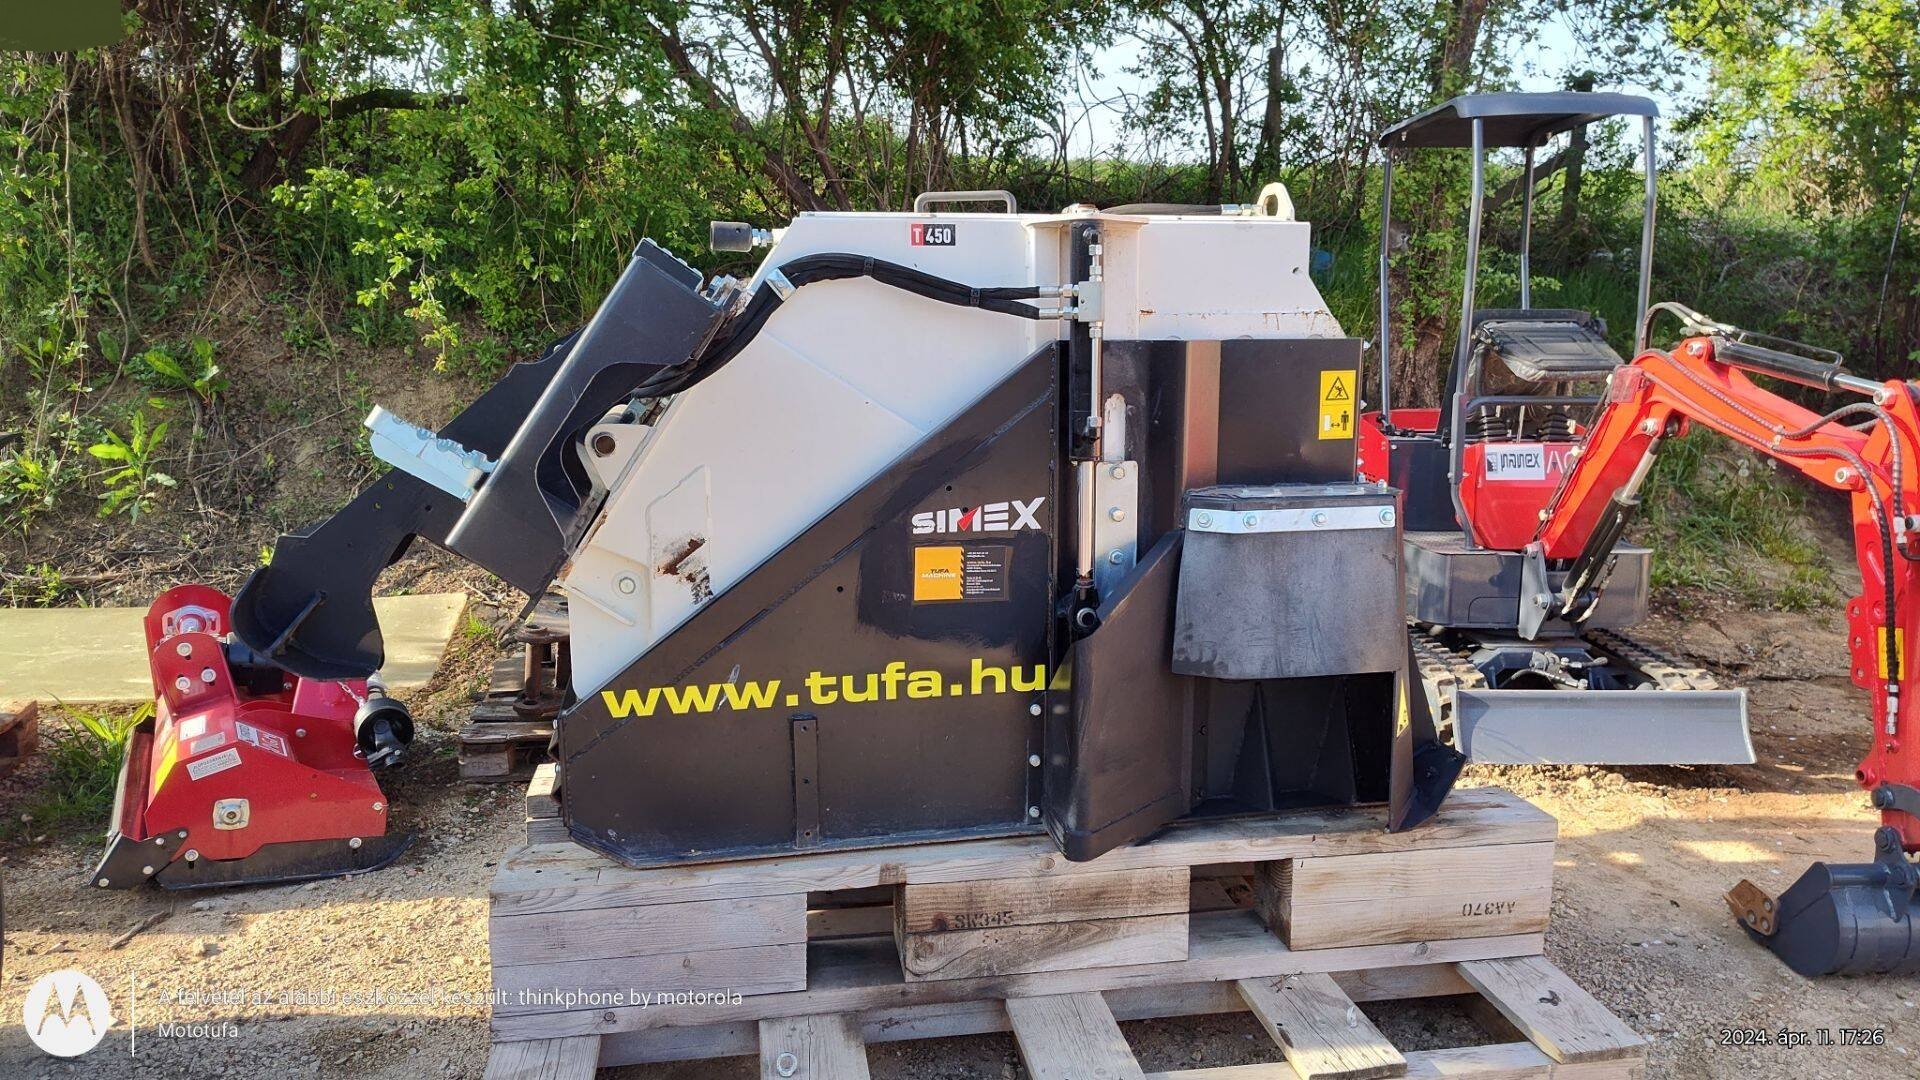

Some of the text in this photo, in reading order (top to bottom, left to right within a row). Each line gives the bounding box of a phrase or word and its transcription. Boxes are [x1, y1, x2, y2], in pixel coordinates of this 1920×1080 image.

[912, 228, 952, 244] T 450
[911, 497, 1046, 535] SIMEX
[601, 658, 1046, 718] www.tufa.hu
